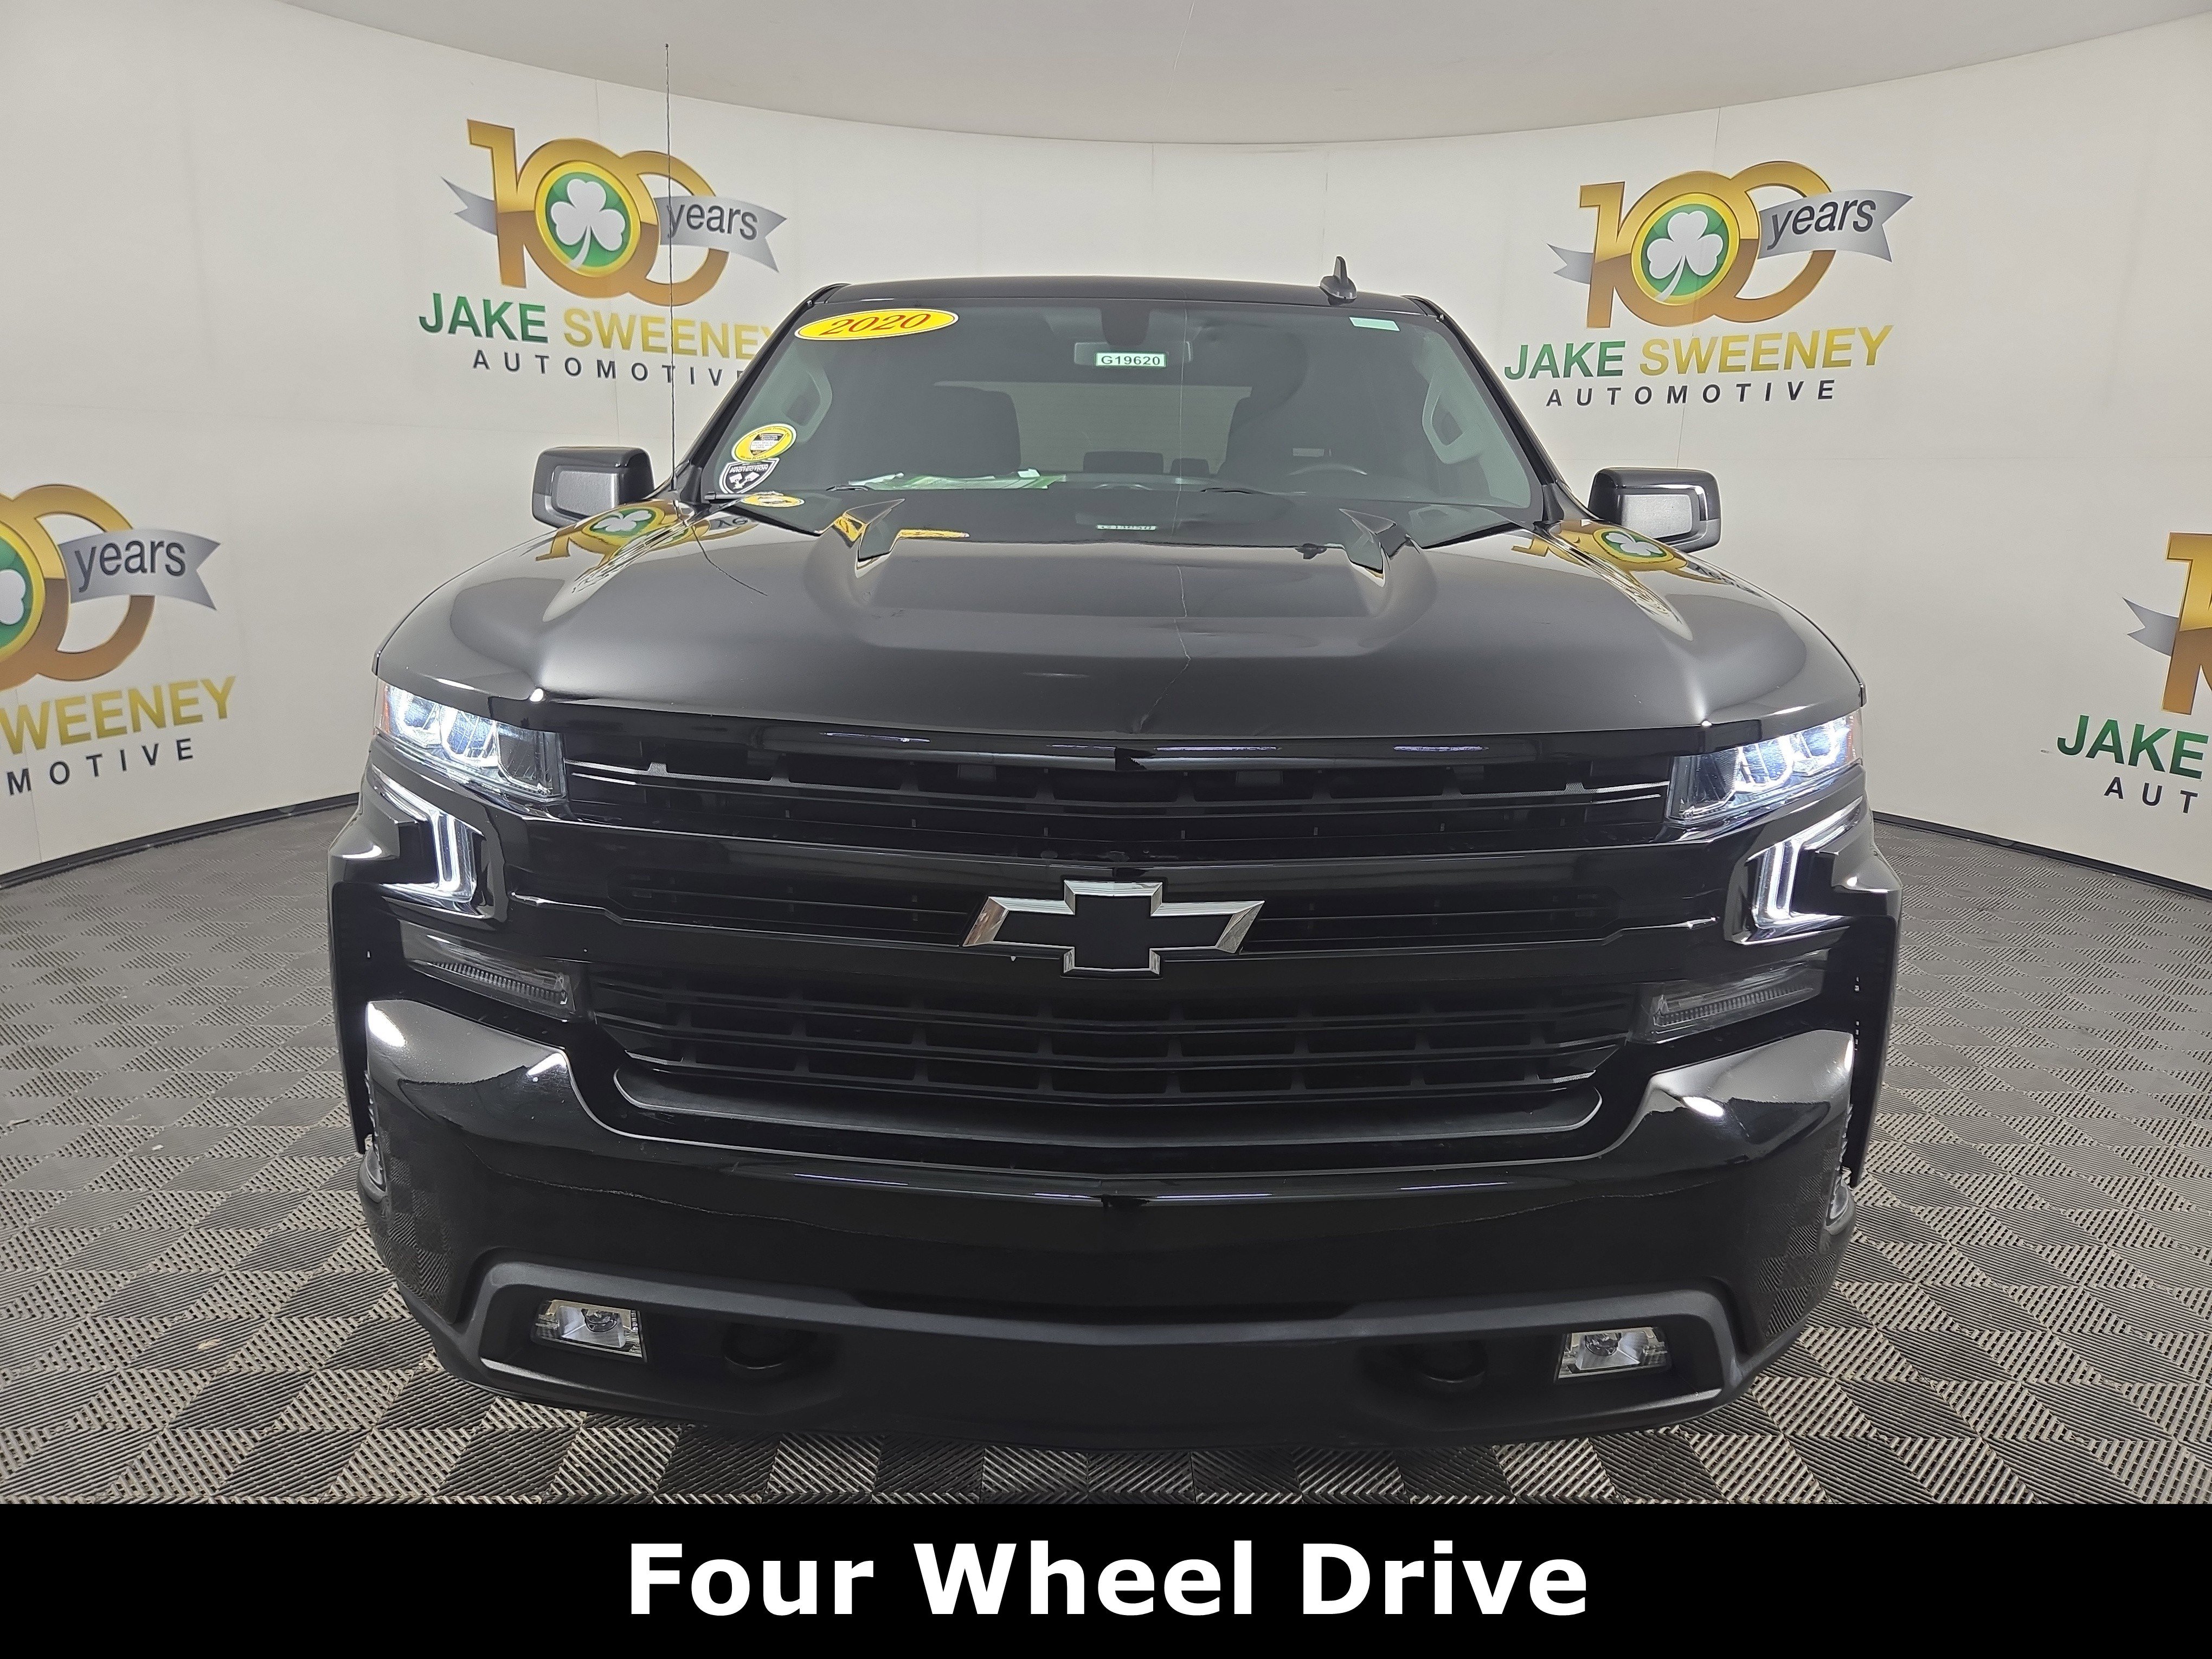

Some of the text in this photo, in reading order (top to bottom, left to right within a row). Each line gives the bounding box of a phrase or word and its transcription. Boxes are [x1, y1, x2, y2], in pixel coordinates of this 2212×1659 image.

[467, 119, 730, 307] 100
[666, 203, 758, 240] years
[1766, 197, 1876, 251] years
[1579, 160, 1837, 329] 100
[419, 293, 772, 360] JAKE SWEENE
[819, 313, 931, 336] 2020
[473, 350, 743, 387] AUTOMOTIV
[1101, 356, 1160, 365] G19620
[1504, 325, 1894, 380] JAKE SWEENEY
[1546, 380, 1835, 407] AUTOMOTIVE
[74, 540, 186, 594] years
[2057, 715, 2209, 780] JAKE
